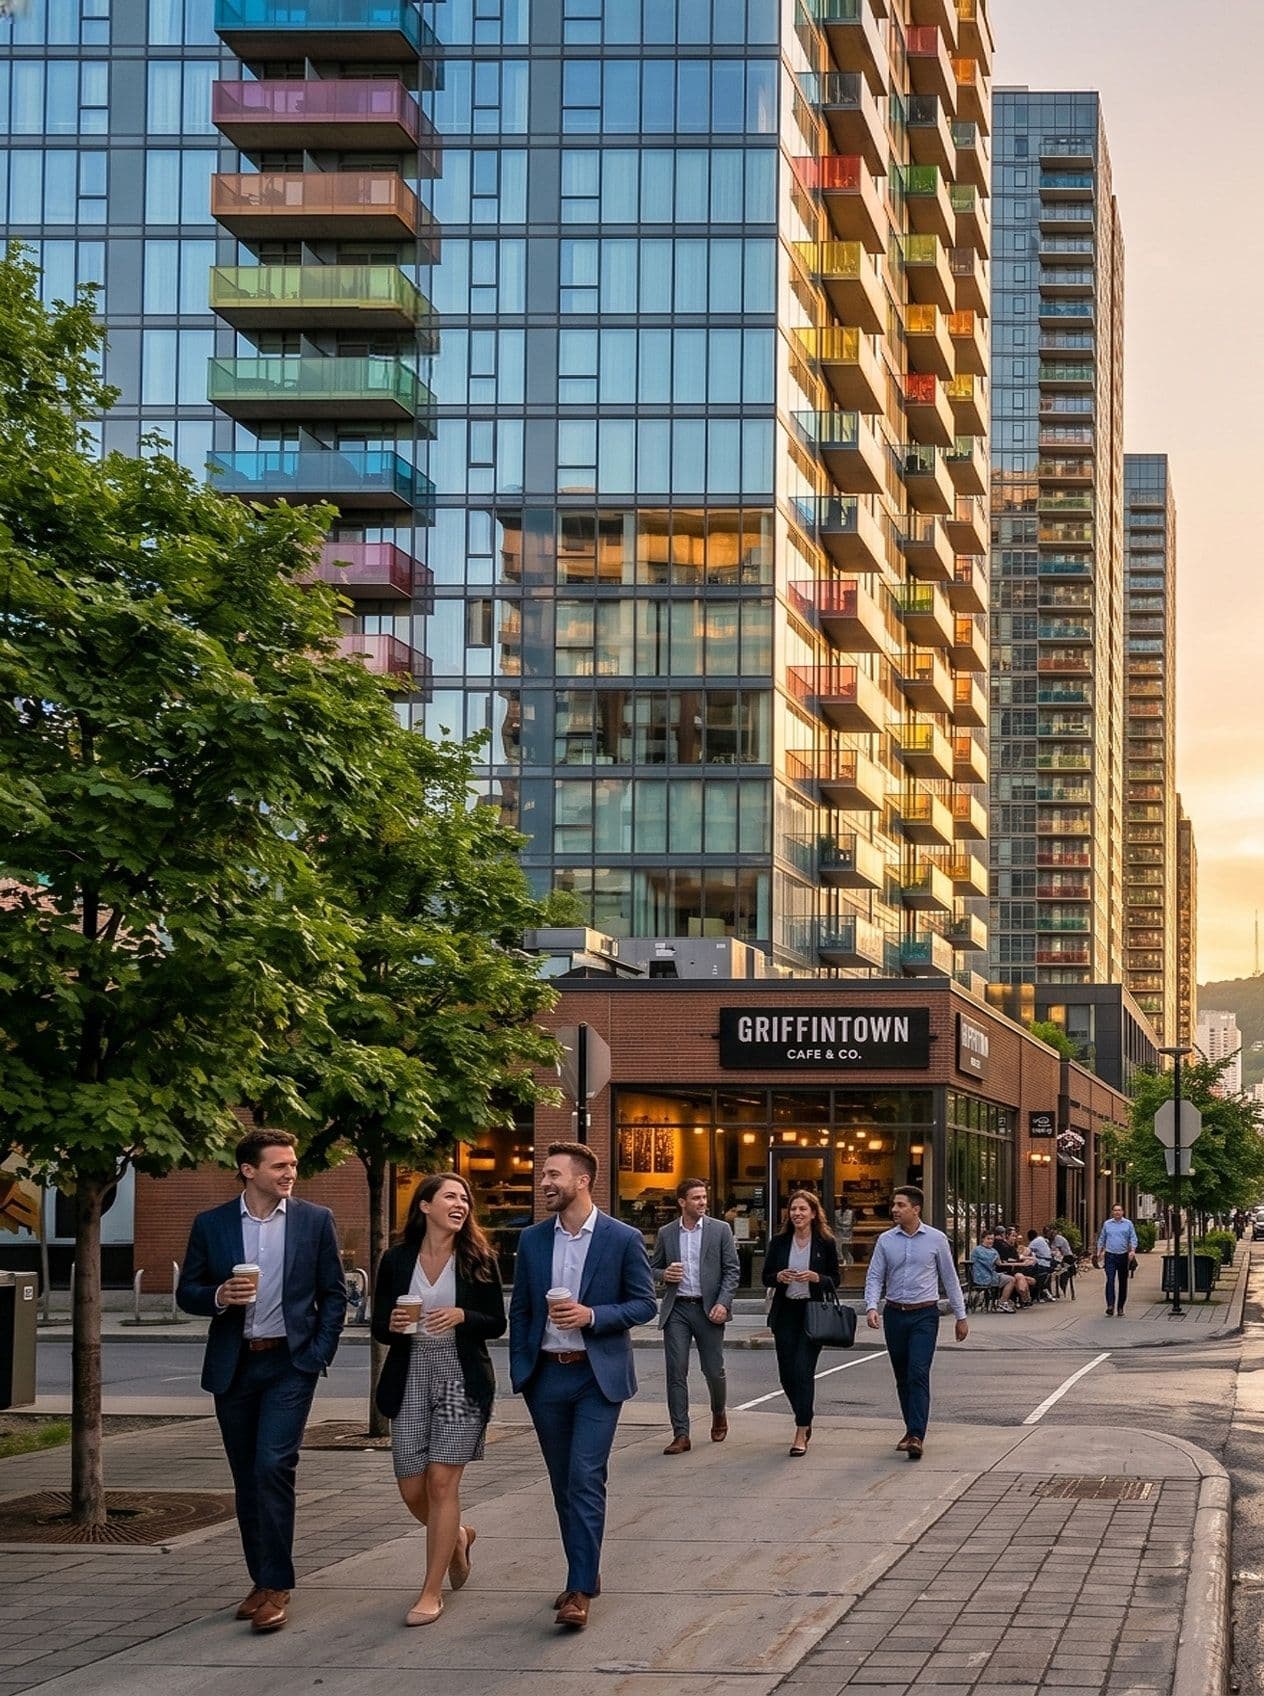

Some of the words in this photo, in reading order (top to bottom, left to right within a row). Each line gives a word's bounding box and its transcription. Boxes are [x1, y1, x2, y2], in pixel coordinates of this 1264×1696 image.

[737, 1016, 910, 1043] GRIFFINTOWN
[786, 1049, 822, 1060] CAFE
[825, 1049, 835, 1060] &
[838, 1049, 862, 1060] CO.
